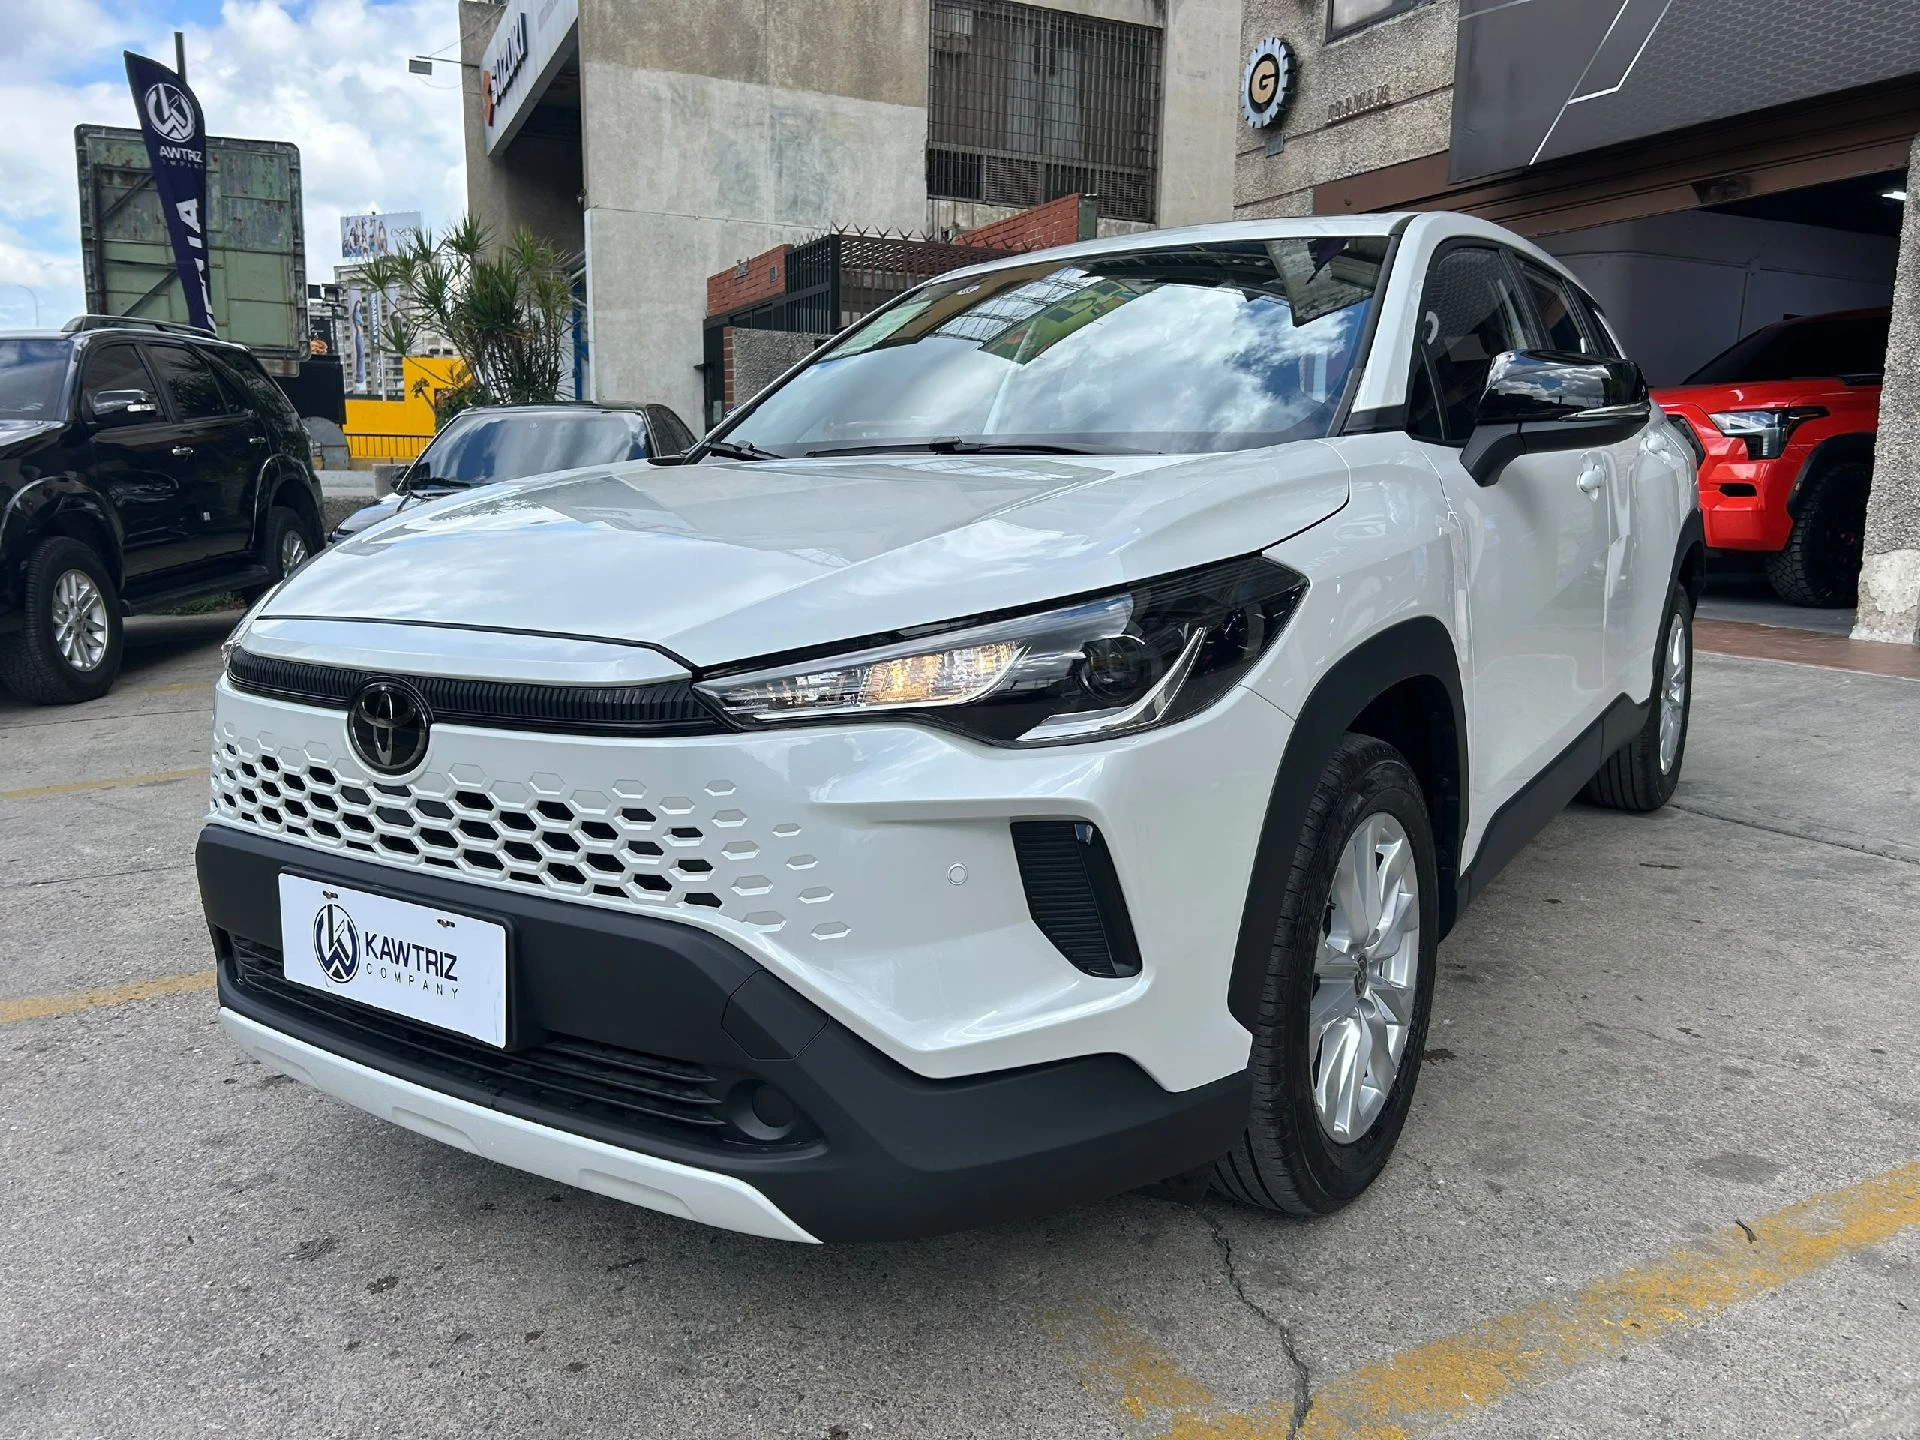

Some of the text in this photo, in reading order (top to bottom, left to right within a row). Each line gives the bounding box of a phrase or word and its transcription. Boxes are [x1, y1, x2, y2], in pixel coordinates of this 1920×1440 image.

[1251, 60, 1276, 104] G
[364, 931, 458, 982] KAWTRIZ
[366, 962, 459, 1000] COMPANY
